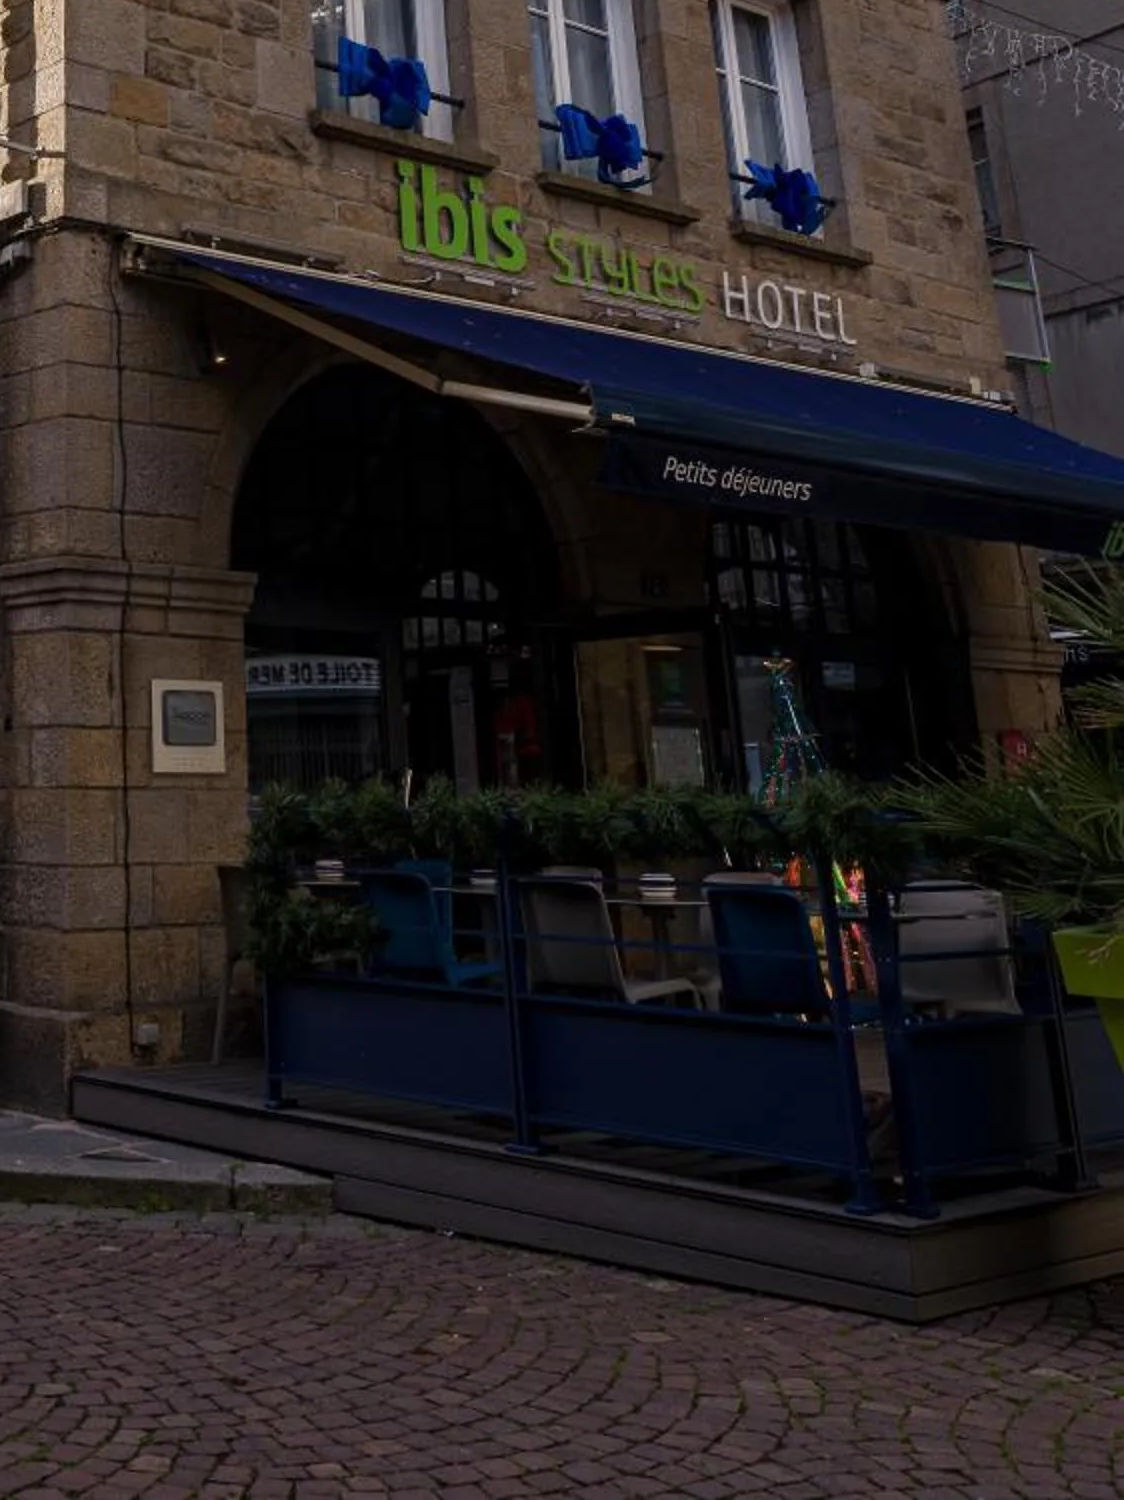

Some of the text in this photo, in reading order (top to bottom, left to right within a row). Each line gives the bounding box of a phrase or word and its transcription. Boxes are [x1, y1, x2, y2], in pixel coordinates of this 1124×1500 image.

[396, 159, 526, 274] ibis
[723, 271, 857, 345] HOTEL
[661, 455, 813, 501] Petits déjeuners
